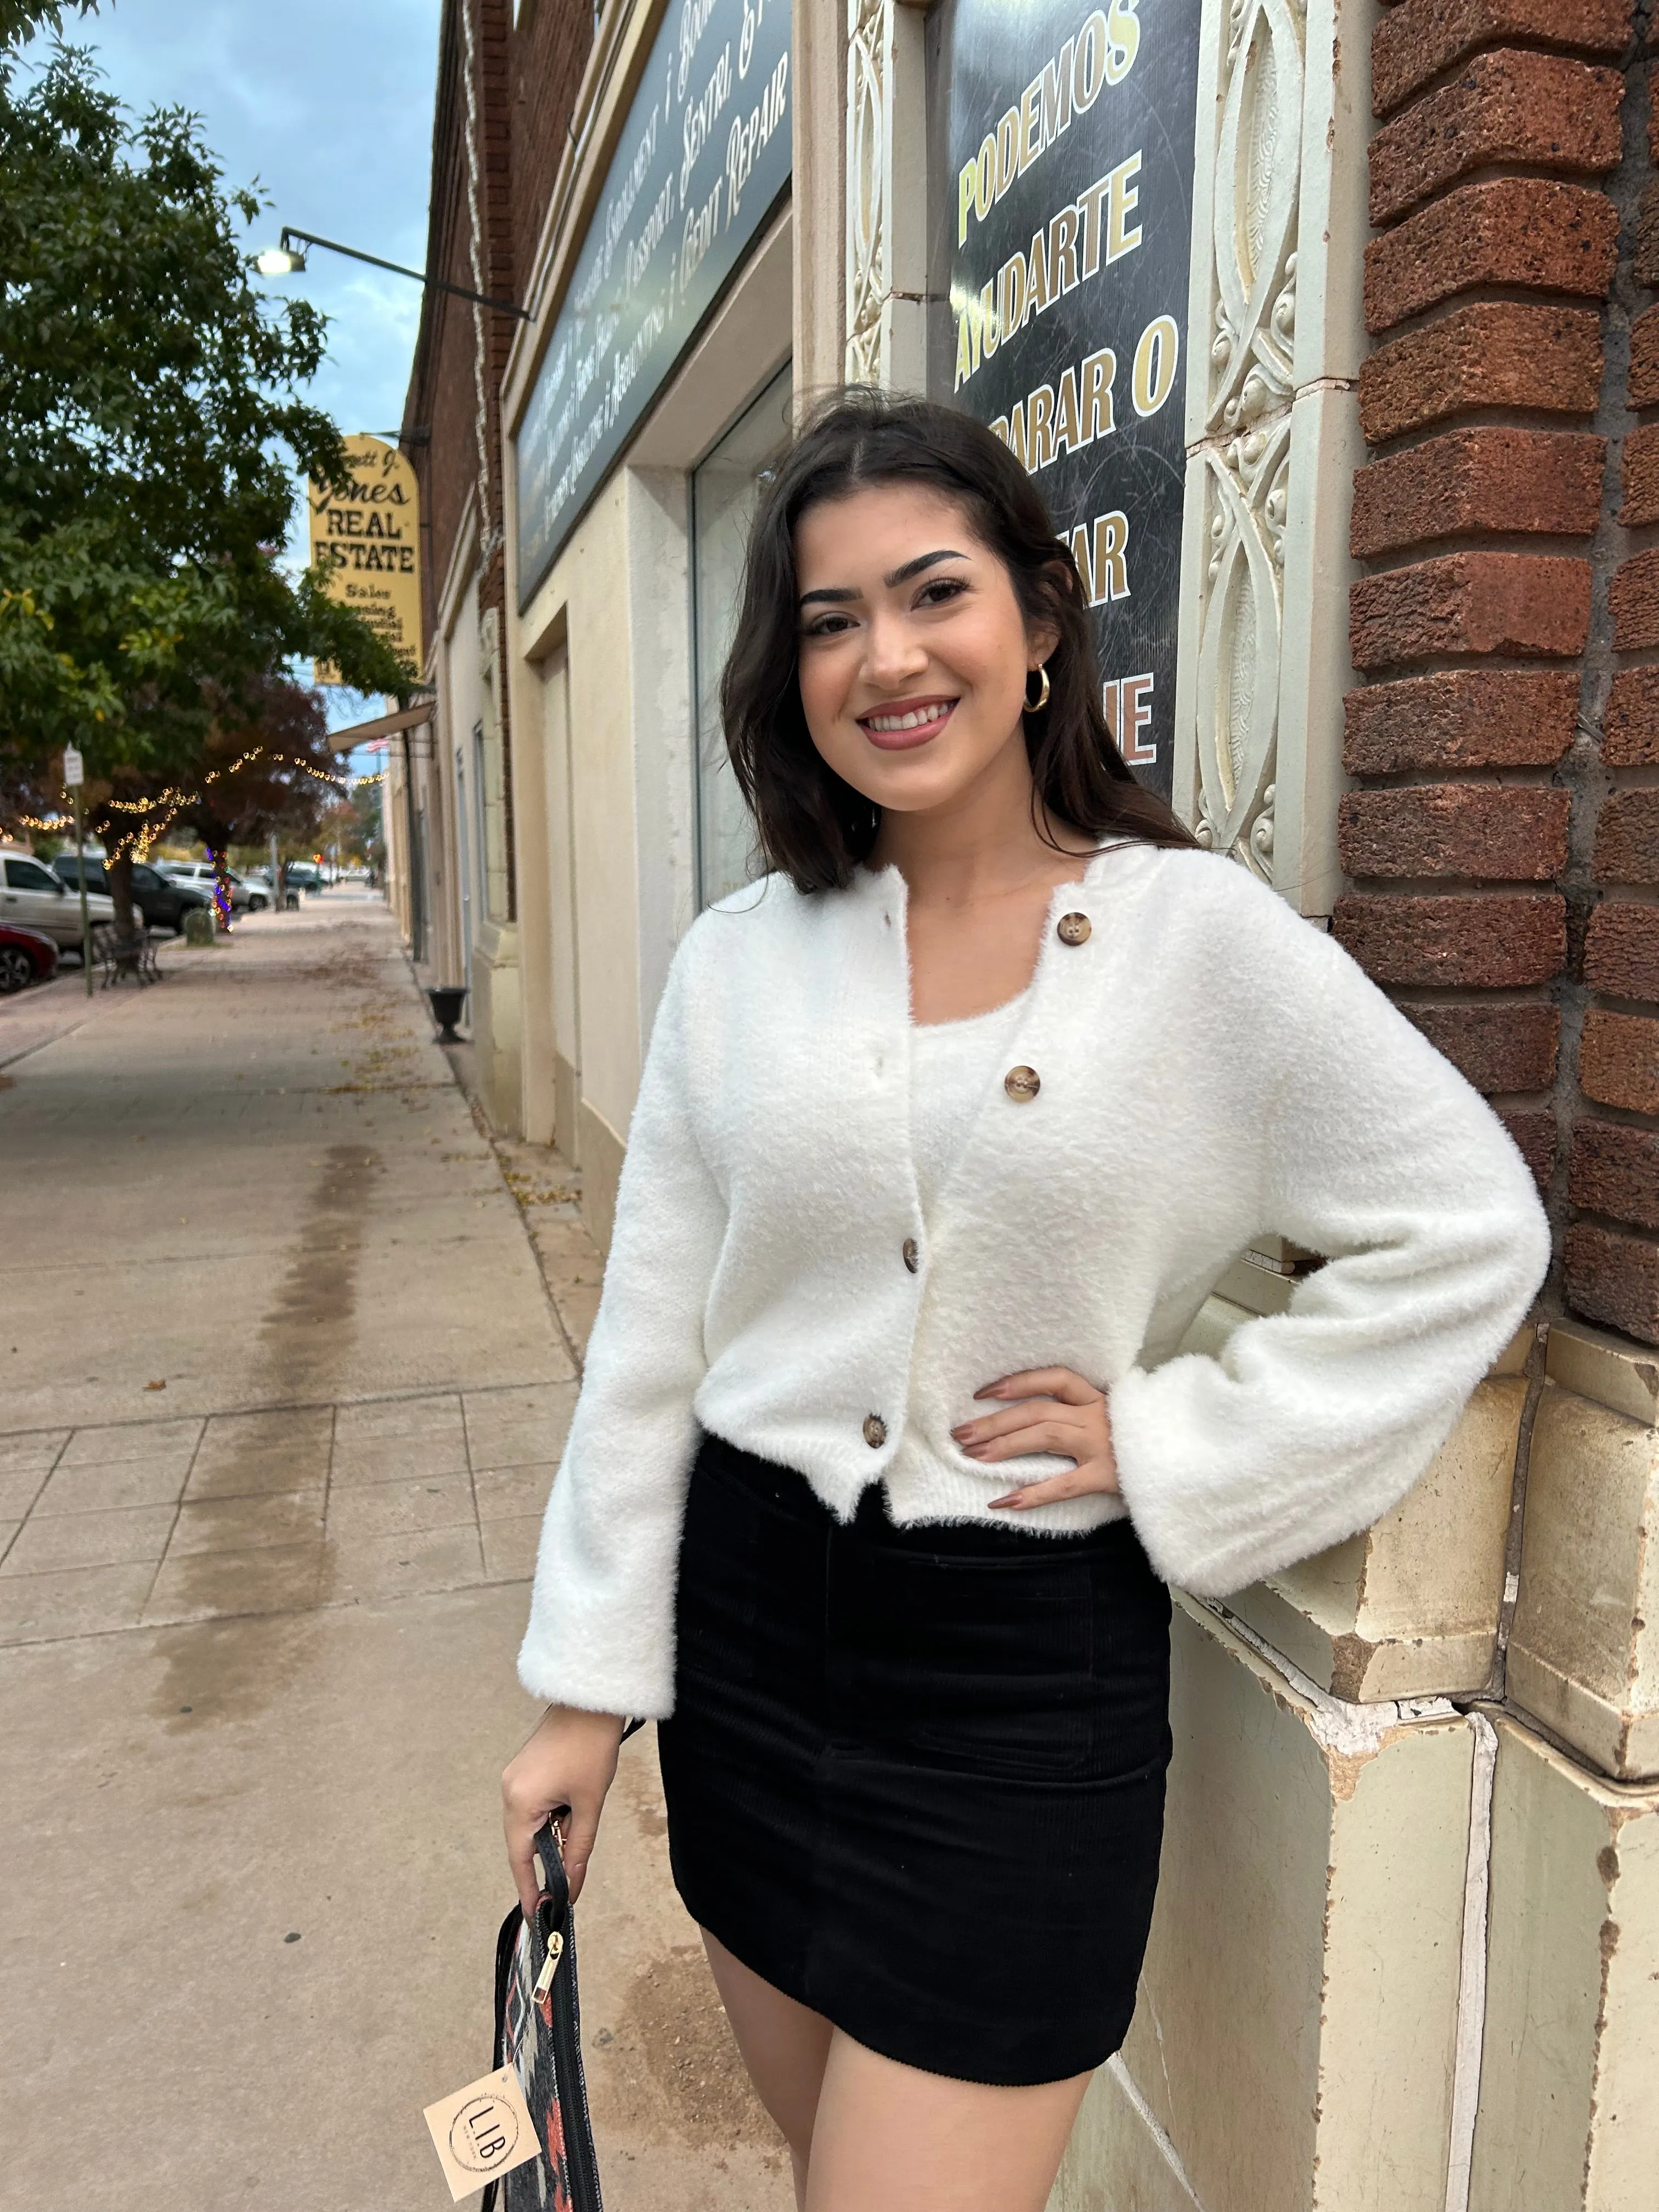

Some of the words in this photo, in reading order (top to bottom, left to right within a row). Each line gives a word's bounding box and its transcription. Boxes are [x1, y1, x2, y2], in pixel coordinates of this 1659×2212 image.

[725, 50, 788, 233] REPAIR
[958, 0, 1140, 249] PODEMOS
[953, 149, 1143, 393] AYUDARTE
[1132, 314, 1179, 417] O
[315, 541, 414, 573] ESTATE
[327, 508, 402, 540] REAL
